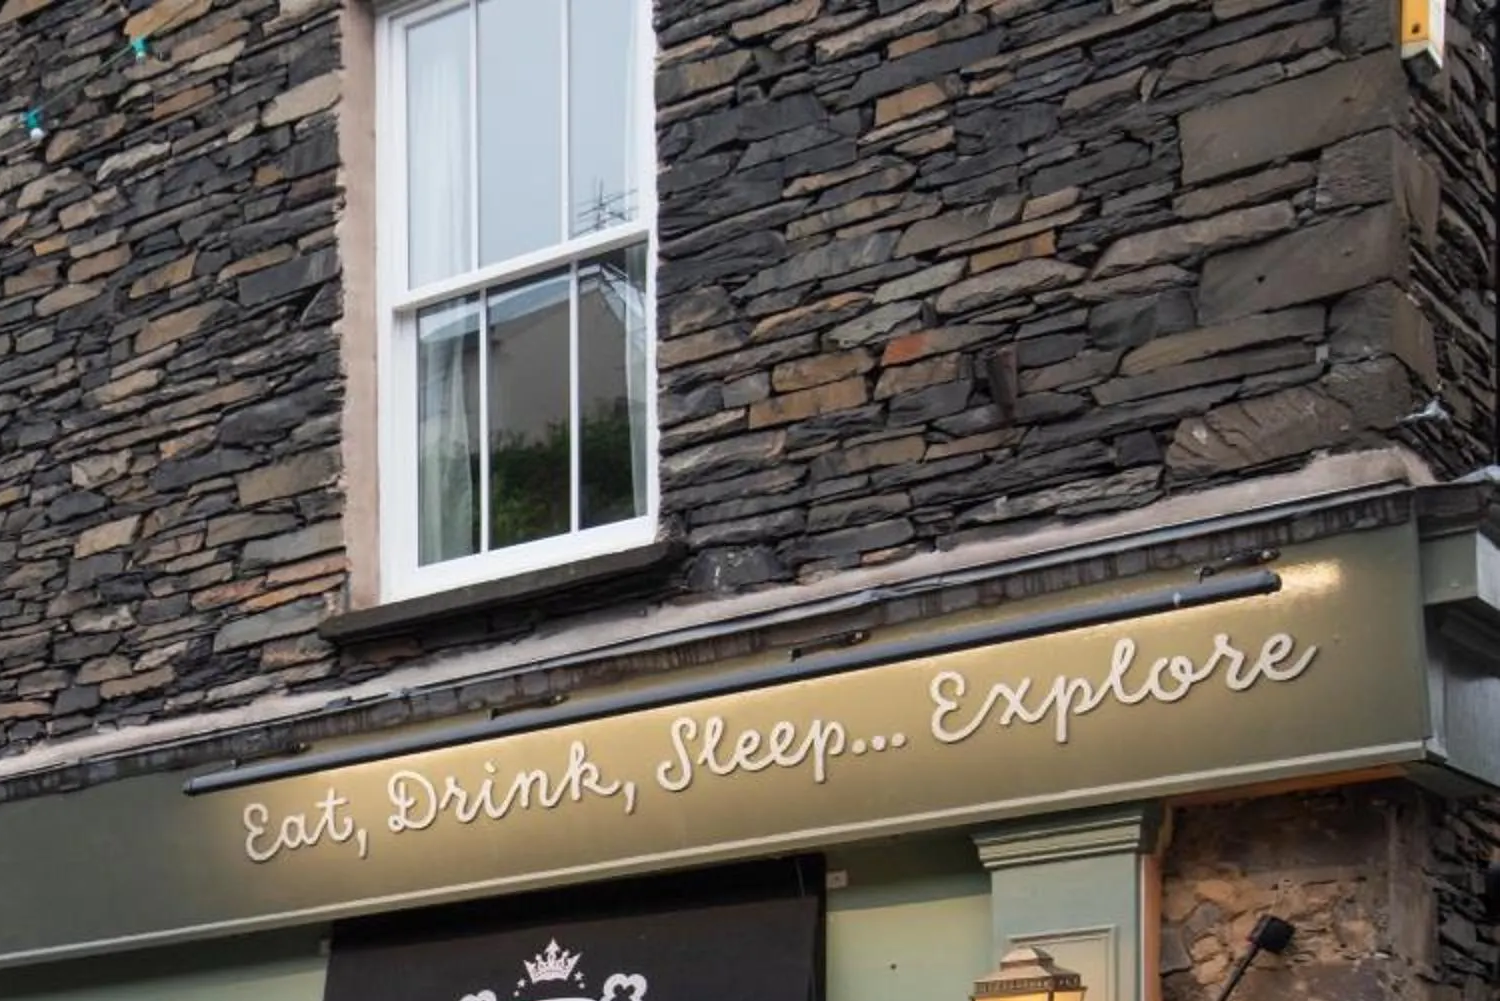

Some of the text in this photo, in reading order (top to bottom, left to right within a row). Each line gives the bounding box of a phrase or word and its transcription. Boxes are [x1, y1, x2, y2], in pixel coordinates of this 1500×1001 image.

[243, 631, 1318, 860] Eat, Drink, Sleep... Explore
